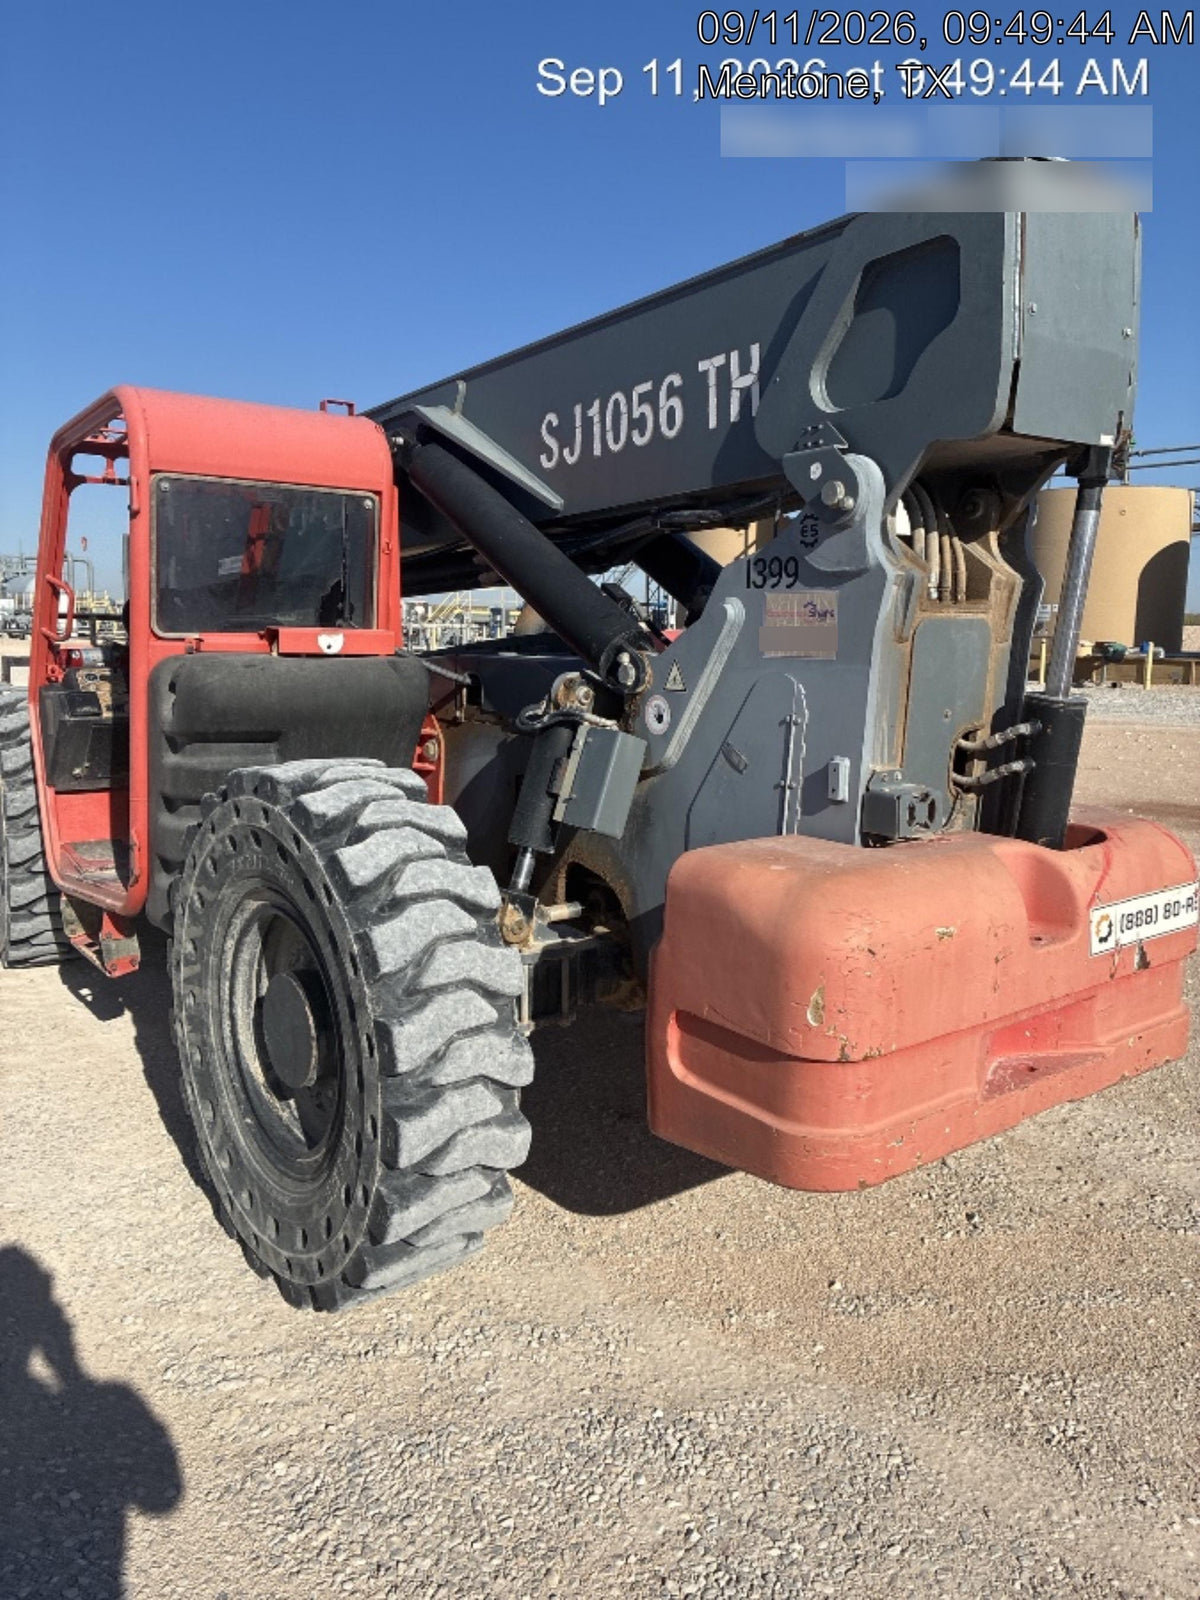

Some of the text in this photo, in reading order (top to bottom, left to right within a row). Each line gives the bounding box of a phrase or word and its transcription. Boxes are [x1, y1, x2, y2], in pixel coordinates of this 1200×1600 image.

[539, 342, 761, 470] SJ1056 TH
[746, 556, 799, 590] 1399
